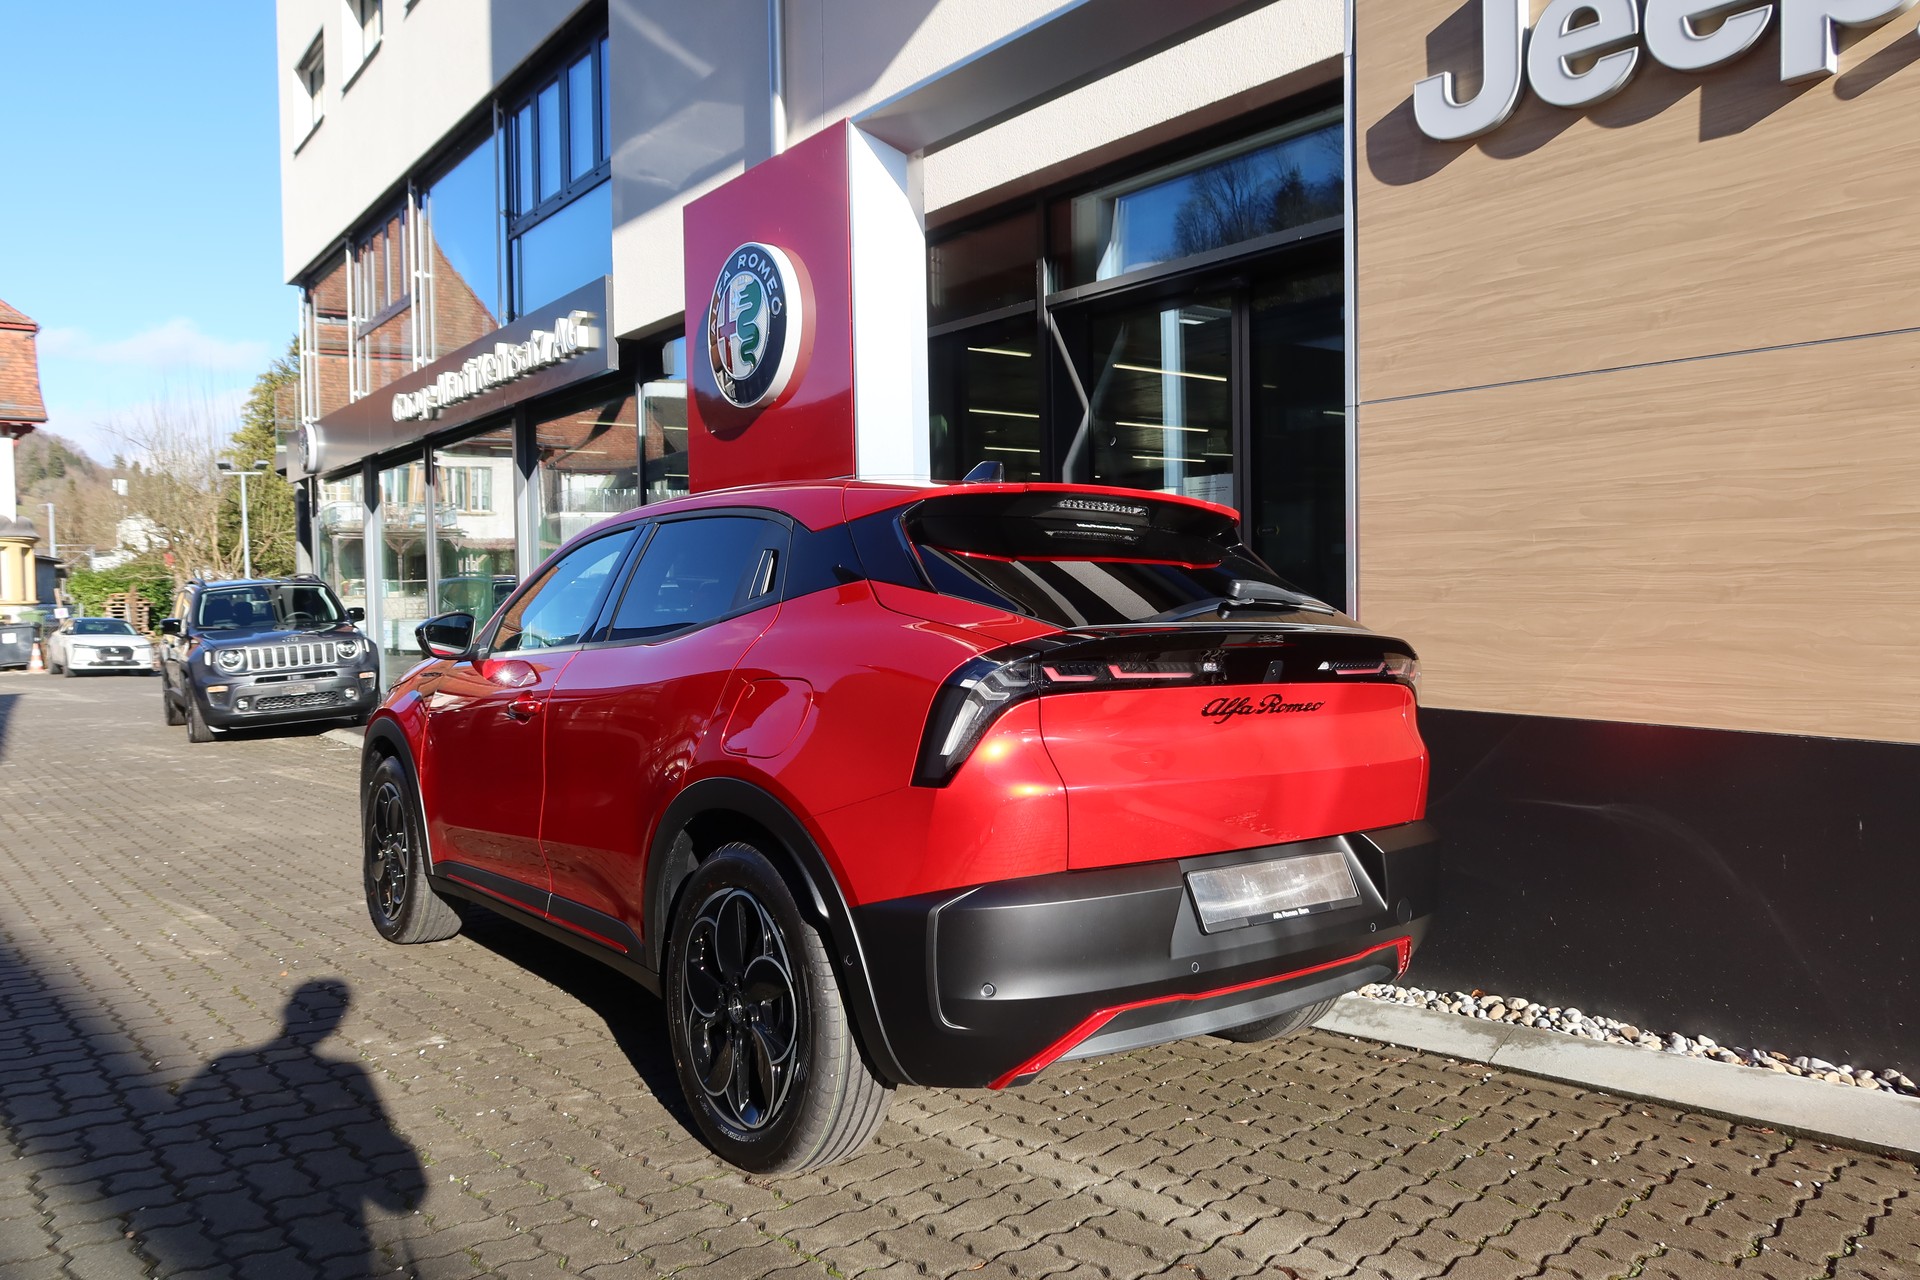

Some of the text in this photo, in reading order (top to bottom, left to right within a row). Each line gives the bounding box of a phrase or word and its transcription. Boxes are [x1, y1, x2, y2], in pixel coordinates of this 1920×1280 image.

[710, 253, 783, 337] ALFA ROMEO
[552, 309, 598, 359] AG
[1201, 693, 1326, 724] Alfa Romeo
